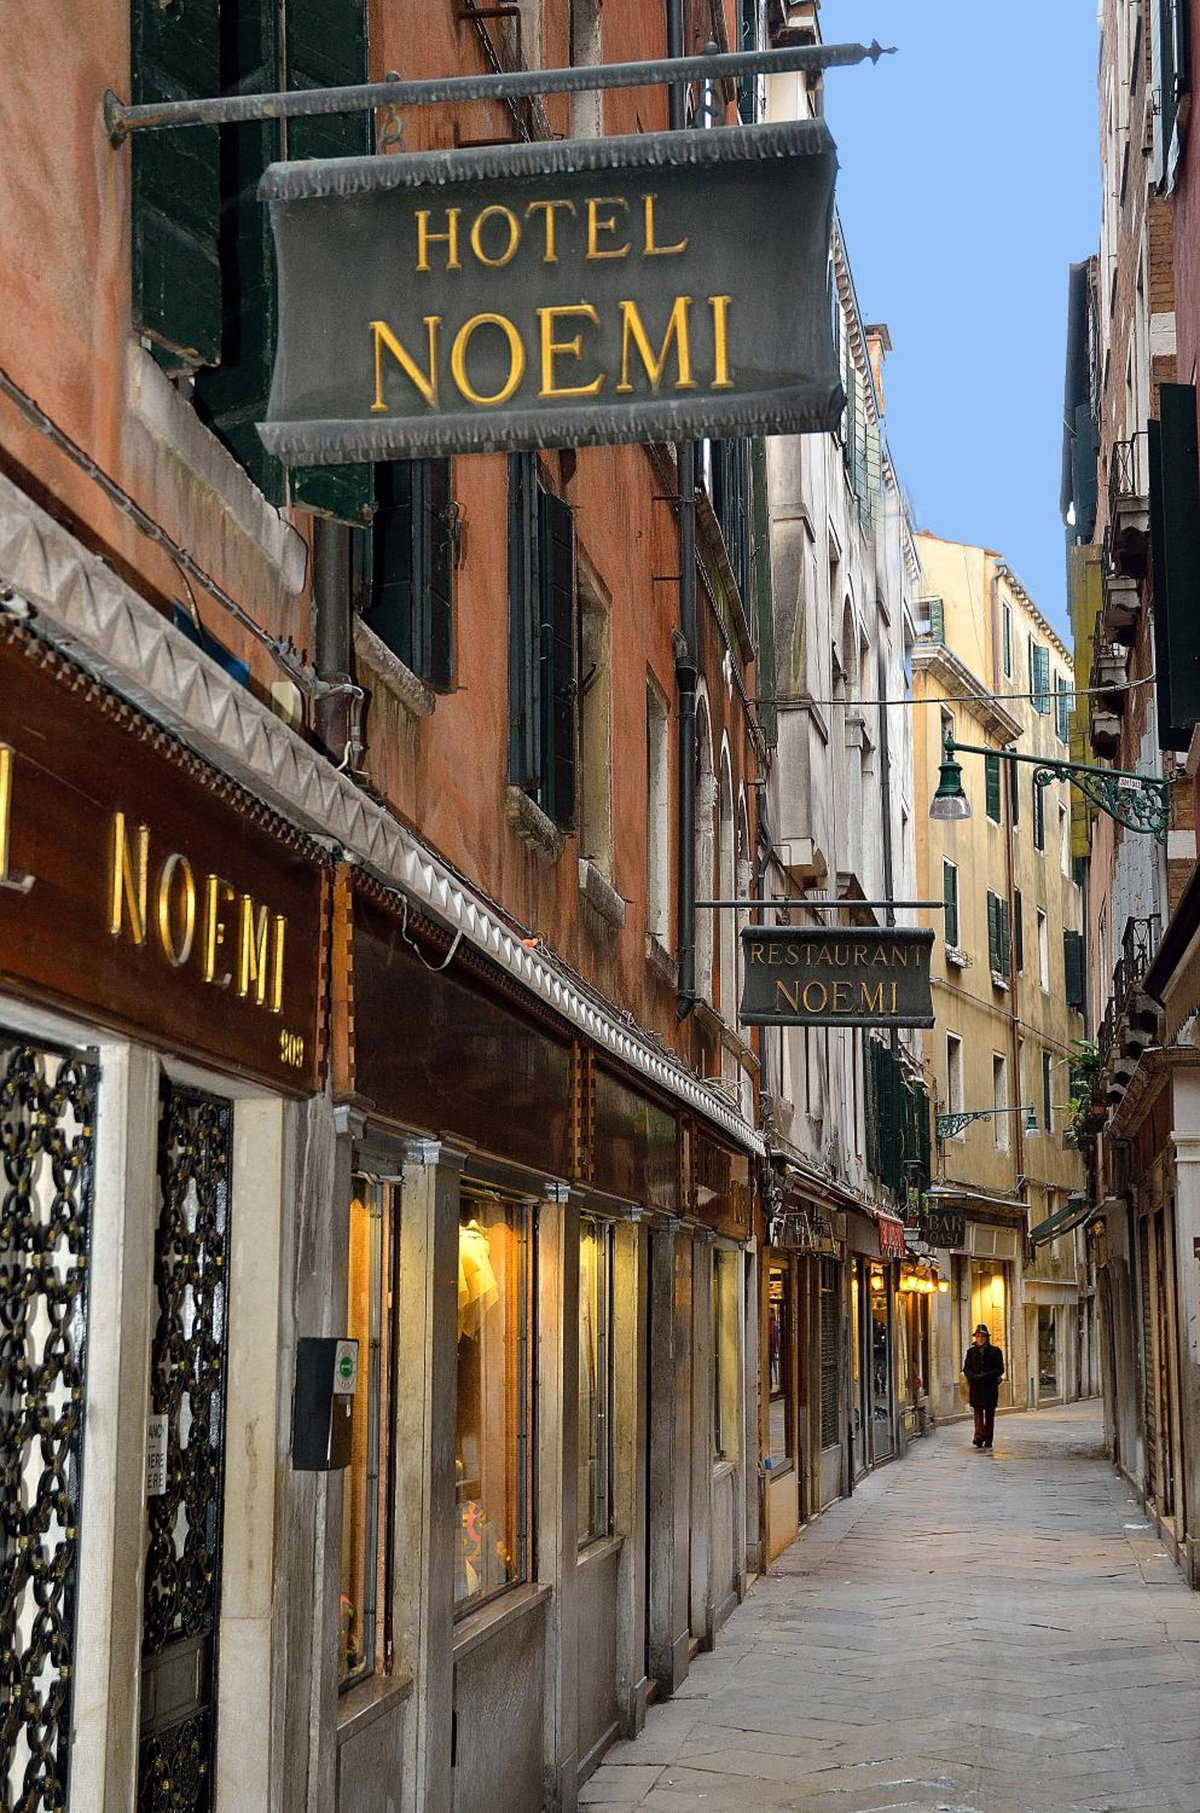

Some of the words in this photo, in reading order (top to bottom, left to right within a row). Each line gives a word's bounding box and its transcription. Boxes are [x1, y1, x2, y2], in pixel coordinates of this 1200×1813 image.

[414, 193, 690, 272] HOTEL
[368, 295, 733, 413] NOEMI
[108, 811, 288, 1013] NOEMI
[749, 942, 927, 968] RESTAURANT
[774, 979, 899, 1015] NOEMI
[928, 1214, 963, 1231] BAR
